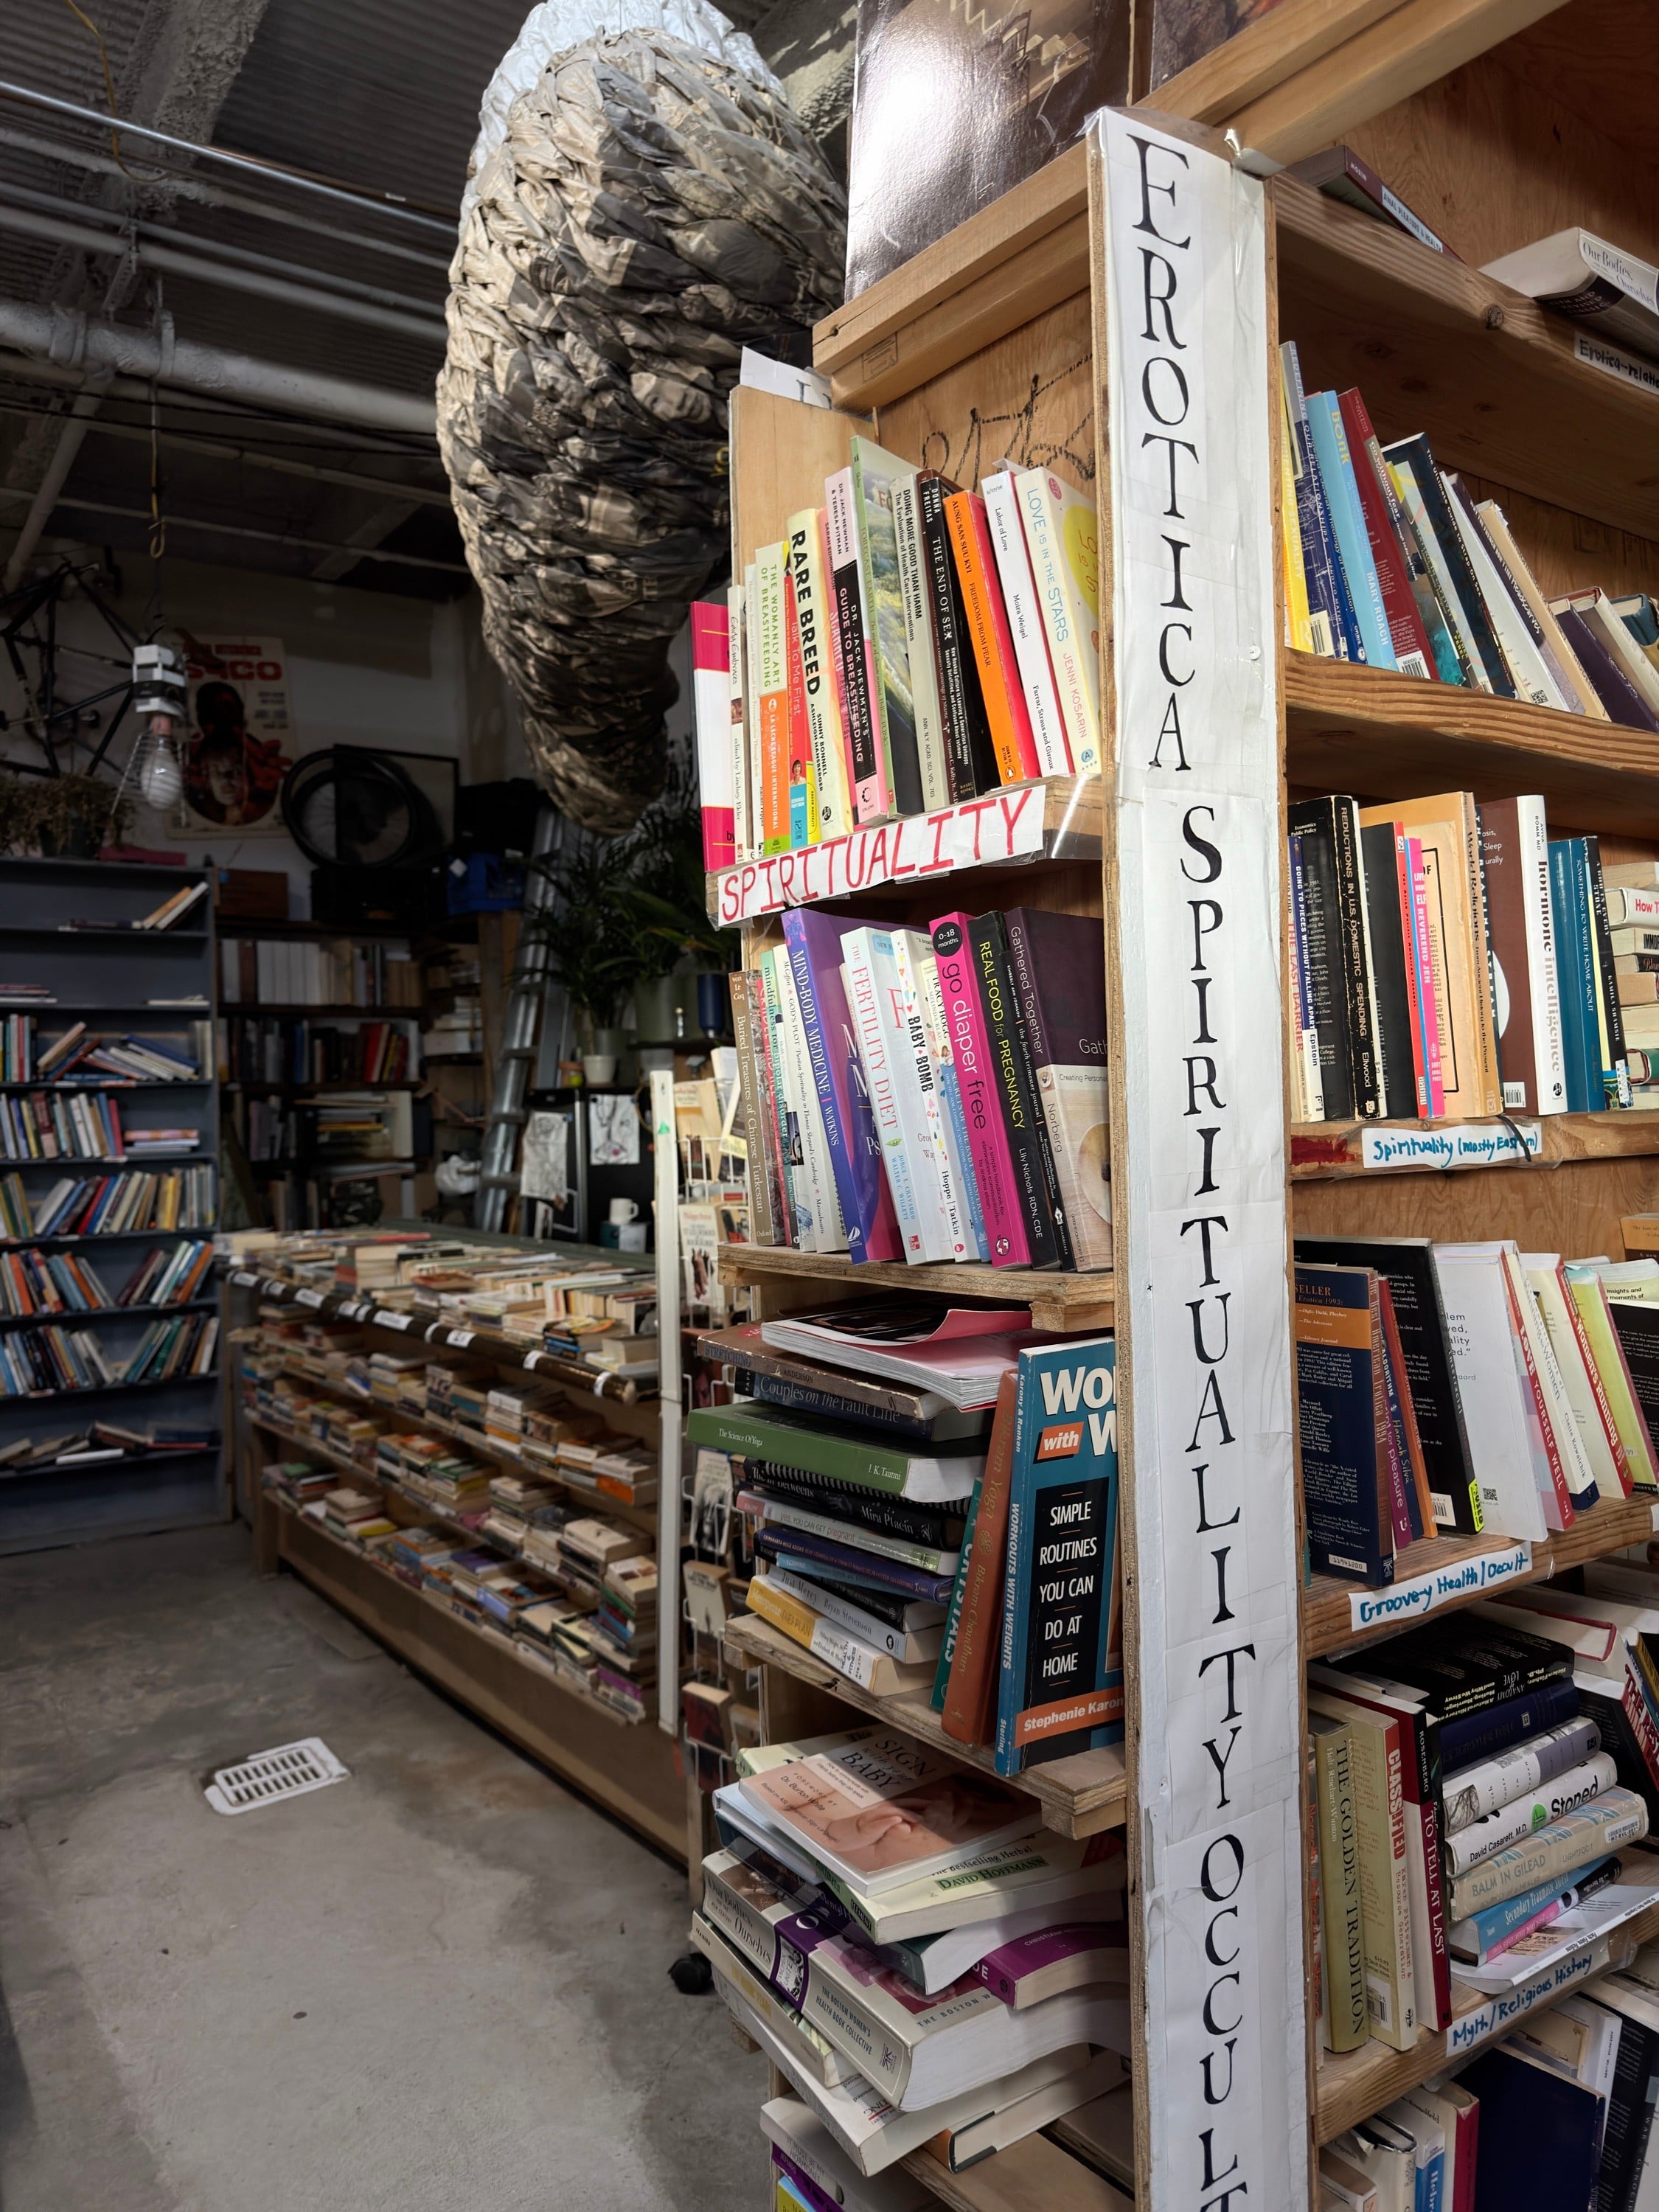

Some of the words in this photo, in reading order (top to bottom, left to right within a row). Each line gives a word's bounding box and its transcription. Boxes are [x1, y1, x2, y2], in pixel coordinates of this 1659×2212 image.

[1383, 193, 1398, 212] ANAL
[1398, 205, 1421, 232] PLEASURE
[1424, 232, 1443, 252] HEALTH
[1583, 242, 1601, 259] Our
[1601, 251, 1634, 280] Bodies,
[1126, 133, 1200, 772] EROTICA
[1331, 410, 1351, 465] bonk
[902, 489, 911, 514] DOING
[922, 491, 933, 524] FREITAS
[931, 488, 941, 514] DONNA
[952, 501, 960, 524] AUNG
[995, 507, 1003, 526] Labor
[1026, 488, 1046, 532] LOVE
[1426, 449, 1434, 465] The
[1433, 467, 1447, 505] Ultimate
[1447, 507, 1458, 532] Guide
[1460, 543, 1478, 585] Strap-On
[905, 518, 914, 541] MORE
[957, 525, 966, 540] SAN
[1038, 535, 1047, 546] IS
[790, 529, 812, 603] RARE
[908, 541, 917, 567] GOOD
[932, 537, 942, 564] THE
[960, 541, 969, 559] SUU
[962, 560, 972, 574] KYI
[1041, 549, 1049, 559] IN
[761, 567, 768, 581] OF
[911, 568, 919, 592] THAN
[936, 568, 947, 593] END
[1044, 563, 1055, 585] THE
[839, 588, 850, 627] GUIDE
[913, 594, 922, 619] HARM
[939, 597, 949, 613] OF
[969, 582, 981, 620] FREEDOM
[1048, 587, 1068, 642] STARS
[1366, 571, 1380, 605] MARY
[1374, 607, 1389, 646] ROACH
[762, 588, 771, 687] BREASTFEEDING
[771, 595, 779, 655] WOMANLY
[844, 629, 852, 650] TO
[940, 613, 953, 641] SEX
[977, 622, 987, 647] FROM
[800, 609, 821, 695] BREED
[852, 631, 863, 663] JACK
[981, 647, 991, 667] FEAR
[846, 653, 863, 762] BREASTFEEDING
[857, 667, 869, 737] NEWMAN'S
[1062, 653, 1078, 686] JENNI
[1070, 689, 1088, 738] KOSARIN
[720, 789, 1032, 922] SPIRITUALITY
[1340, 807, 1353, 879] REDUCTIONS
[1295, 866, 1304, 890] GOING
[1298, 891, 1304, 902] TO
[1347, 883, 1354, 894] IN
[1348, 898, 1357, 917] U.S.
[1538, 860, 1552, 953] hormone
[1635, 899, 1652, 913] How
[851, 945, 861, 961] THE
[937, 937, 959, 949] months
[939, 928, 955, 940] 0-18
[1302, 934, 1310, 970] WITHOUT
[1350, 921, 1362, 977] DOMESTIC
[979, 941, 992, 978] REAL
[987, 978, 1004, 1022] FOOD
[1011, 926, 1032, 990] Gathered
[1024, 992, 1043, 1054] Together
[1304, 971, 1312, 1004] FALLING
[791, 950, 817, 1026] MIND-BODY
[807, 1026, 830, 1095] MEDICINE
[852, 967, 887, 1076] FERTILITY
[1356, 982, 1367, 1037] SPENDING
[1544, 956, 1561, 1072] intelligence
[737, 1016, 746, 1050] Buried
[908, 1015, 926, 1049] BABY
[942, 963, 962, 993] go
[953, 999, 978, 1074] diaper
[967, 1079, 986, 1130] free
[994, 1023, 1004, 1037] for
[741, 1052, 751, 1101] Treasures
[916, 1055, 933, 1093] BOMB
[998, 1039, 1026, 1129] PREGNANCY
[1361, 1051, 1371, 1088] Ellwood
[746, 1104, 753, 1115] of
[874, 1079, 898, 1130] DIET
[747, 1116, 757, 1159] Chinese
[825, 1105, 839, 1146] WATKINS
[1047, 1103, 1062, 1153] Norberg
[1373, 1135, 1453, 1169] Spirituality
[1458, 1137, 1496, 1161] (mostly
[752, 1162, 763, 1213] Turkestan
[942, 1170, 952, 1200] Hoppe
[948, 1204, 959, 1235] Tatkin
[1179, 806, 1256, 1809] SPIRITUALITY
[759, 1376, 804, 1401] Couples
[805, 1391, 819, 1403] on
[821, 1394, 839, 1408] the
[1520, 1326, 1535, 1376] LOVE
[1534, 1379, 1554, 1448] YOURSELF
[1552, 1453, 1564, 1490] WELL
[1043, 1430, 1079, 1451] with
[1388, 1450, 1403, 1508] pleasure
[1049, 1501, 1092, 1526] SIMPLE
[1007, 1503, 1020, 1575] WORKOUTS
[1040, 1537, 1097, 1565] ROUTINES
[782, 1572, 797, 1590] Just
[797, 1581, 818, 1605] Mercy
[824, 1599, 841, 1616] Bryan
[842, 1610, 872, 1635] Stevenson
[1006, 1578, 1016, 1610] WITH
[1039, 1585, 1065, 1604] YOU
[1068, 1575, 1094, 1596] CAN
[1360, 1585, 1433, 1623] Groove-y
[1436, 1566, 1478, 1594] Health
[1488, 1552, 1528, 1578] Occult
[1003, 1610, 1015, 1669] WEIGHTS
[1045, 1619, 1063, 1641] DO
[1066, 1615, 1082, 1635] AT
[1043, 1652, 1079, 1678] HOME
[1024, 1706, 1086, 1732] Stephenie
[841, 1752, 901, 1790] BABY
[875, 1739, 936, 1778] SIGN
[1335, 1740, 1349, 1792] THE
[1419, 1731, 1429, 1793] ROSENBERG
[1388, 1748, 1406, 1860] CLASSIFIED
[1551, 1775, 1599, 1820] Stoned
[1424, 1810, 1434, 1837] TO
[1339, 1798, 1357, 1896] GOLDEN
[1470, 1845, 1487, 1863] David
[1488, 1831, 1514, 1854] Casarett,
[1515, 1823, 1528, 1836] M.D.
[939, 1874, 979, 1890] DAVID
[981, 1857, 1046, 1879] HOFFMANN
[1425, 1840, 1439, 1885] TELL
[1472, 1879, 1498, 1897] BALM
[1500, 1869, 1511, 1883] IN
[1514, 1854, 1545, 1877] GILEAD
[1430, 1890, 1439, 1907] AT
[734, 1920, 772, 1964] Ourselves
[1432, 1912, 1445, 1955] LAST
[1346, 1899, 1365, 2035] TRADITION
[1555, 1955, 1593, 1985] History
